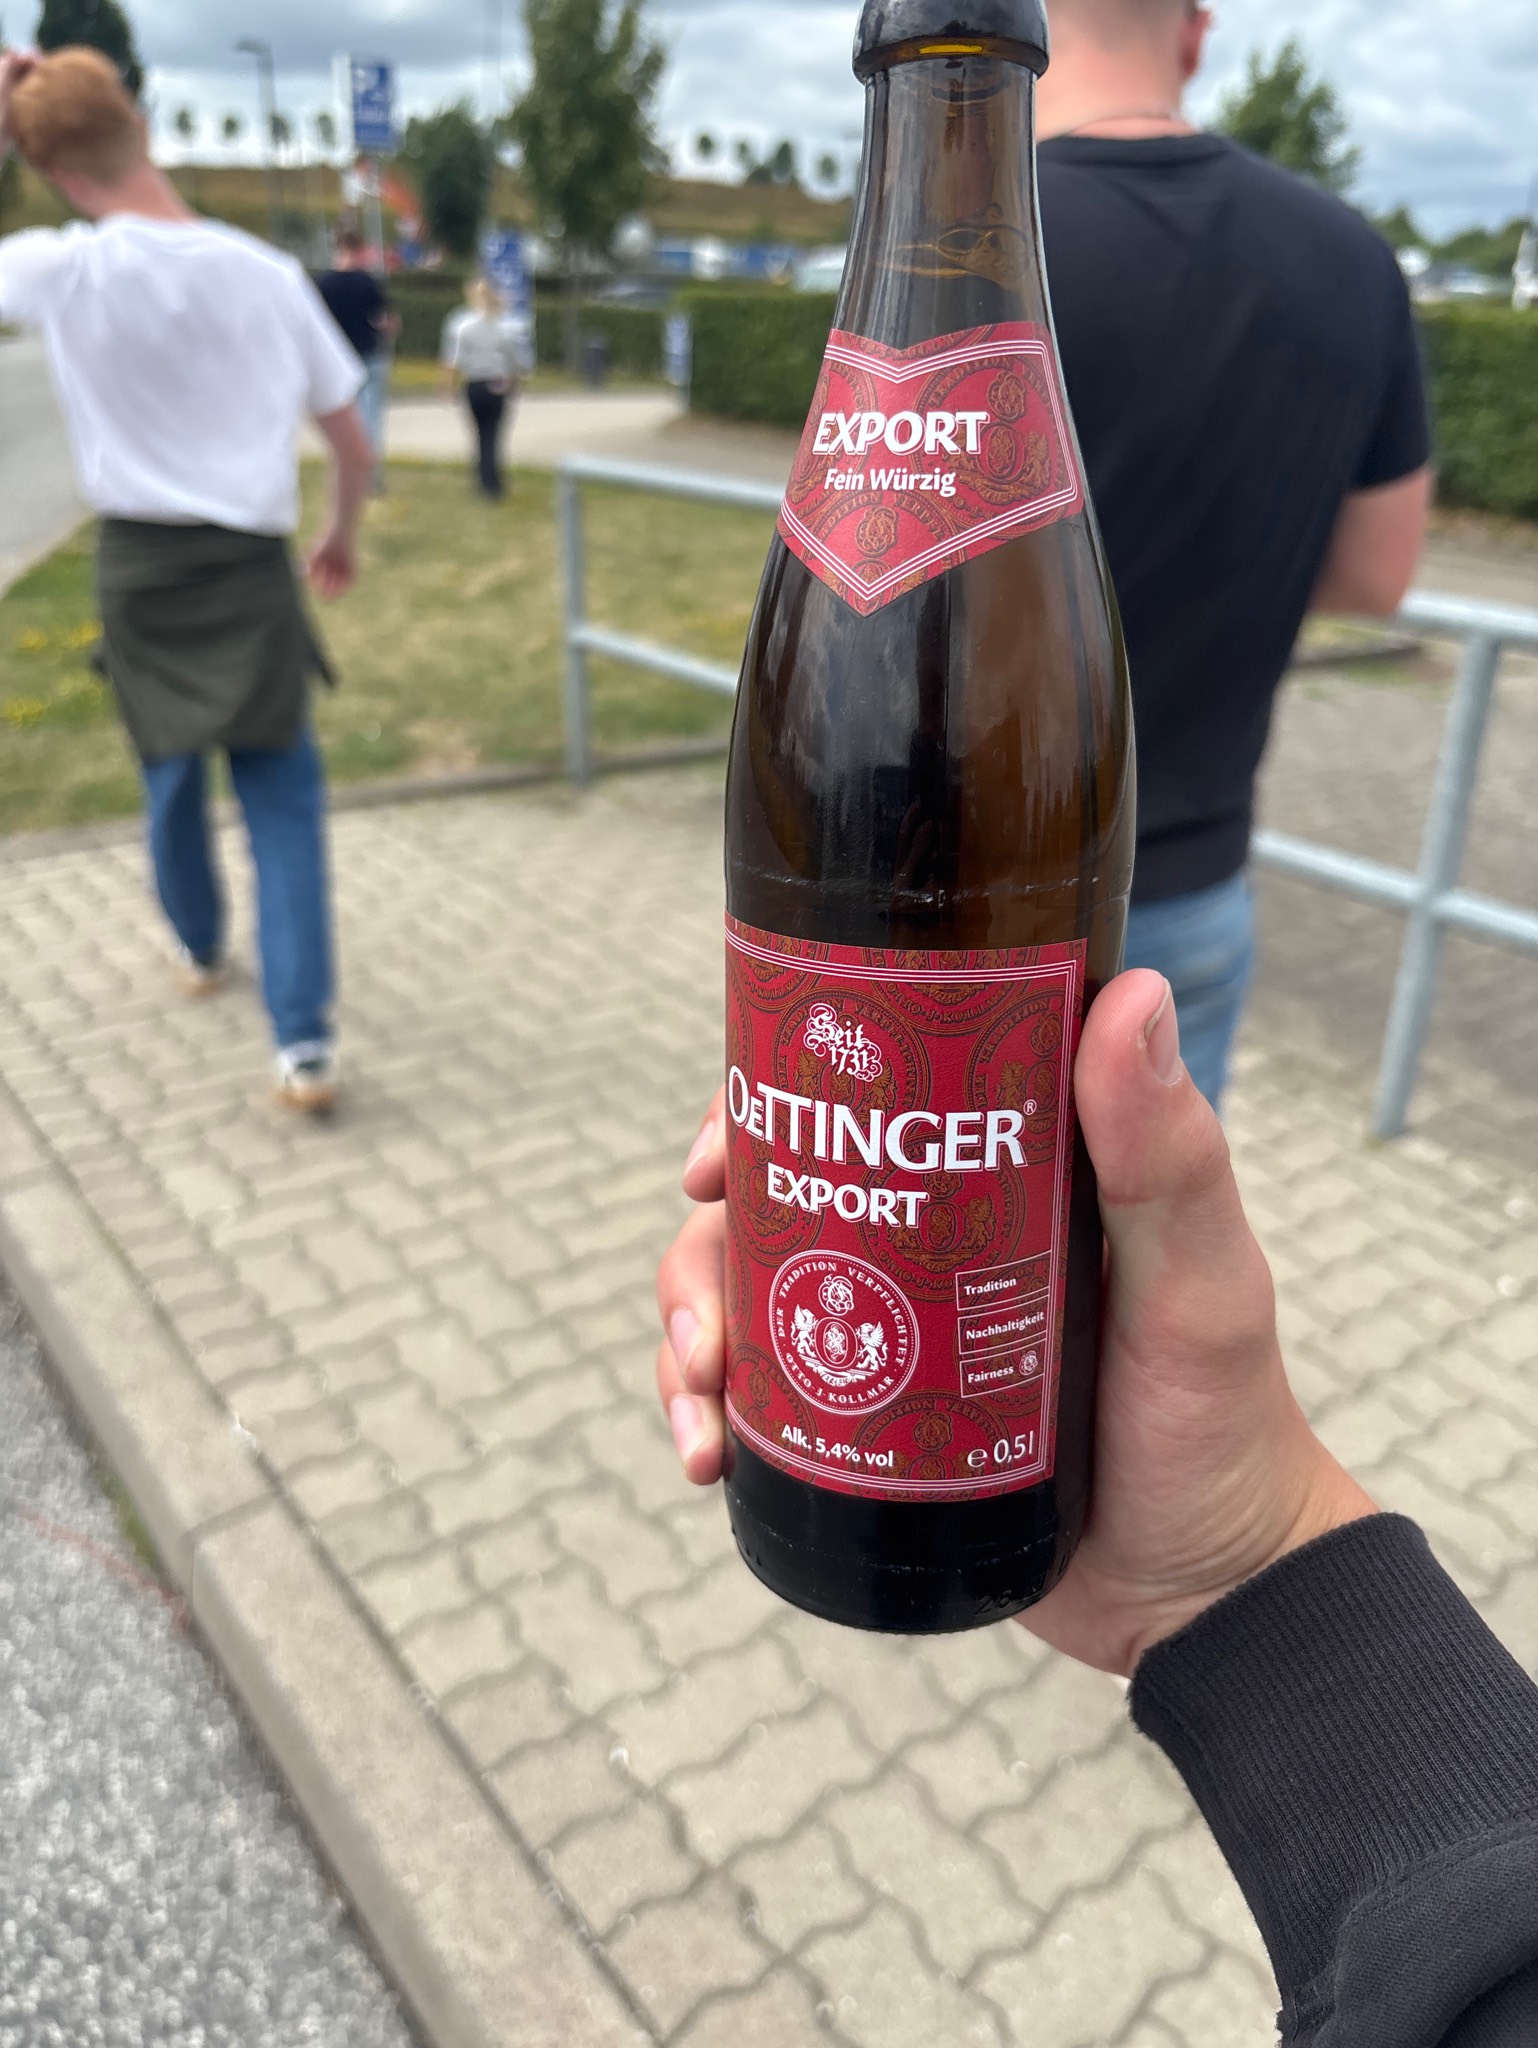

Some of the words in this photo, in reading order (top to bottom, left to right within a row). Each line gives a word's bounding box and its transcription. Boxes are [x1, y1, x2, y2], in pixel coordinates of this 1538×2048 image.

[813, 411, 989, 455] EXPORT
[824, 469, 865, 490] Fein
[870, 468, 957, 497] Würzig
[803, 1003, 864, 1057] Seit
[828, 1041, 882, 1082] 1731
[767, 1163, 929, 1228] EXPORT
[779, 1261, 838, 1298] TRADITION
[964, 1277, 1017, 1296] Tradition
[777, 1307, 786, 1338] DER
[848, 1267, 908, 1367] VERPFLICHTET
[965, 1311, 1044, 1340] Nachhaltigkeit
[967, 1365, 1014, 1384] Fairness
[781, 1424, 812, 1450] Alk.
[815, 1438, 861, 1463] 5,4%
[865, 1451, 894, 1467] vol
